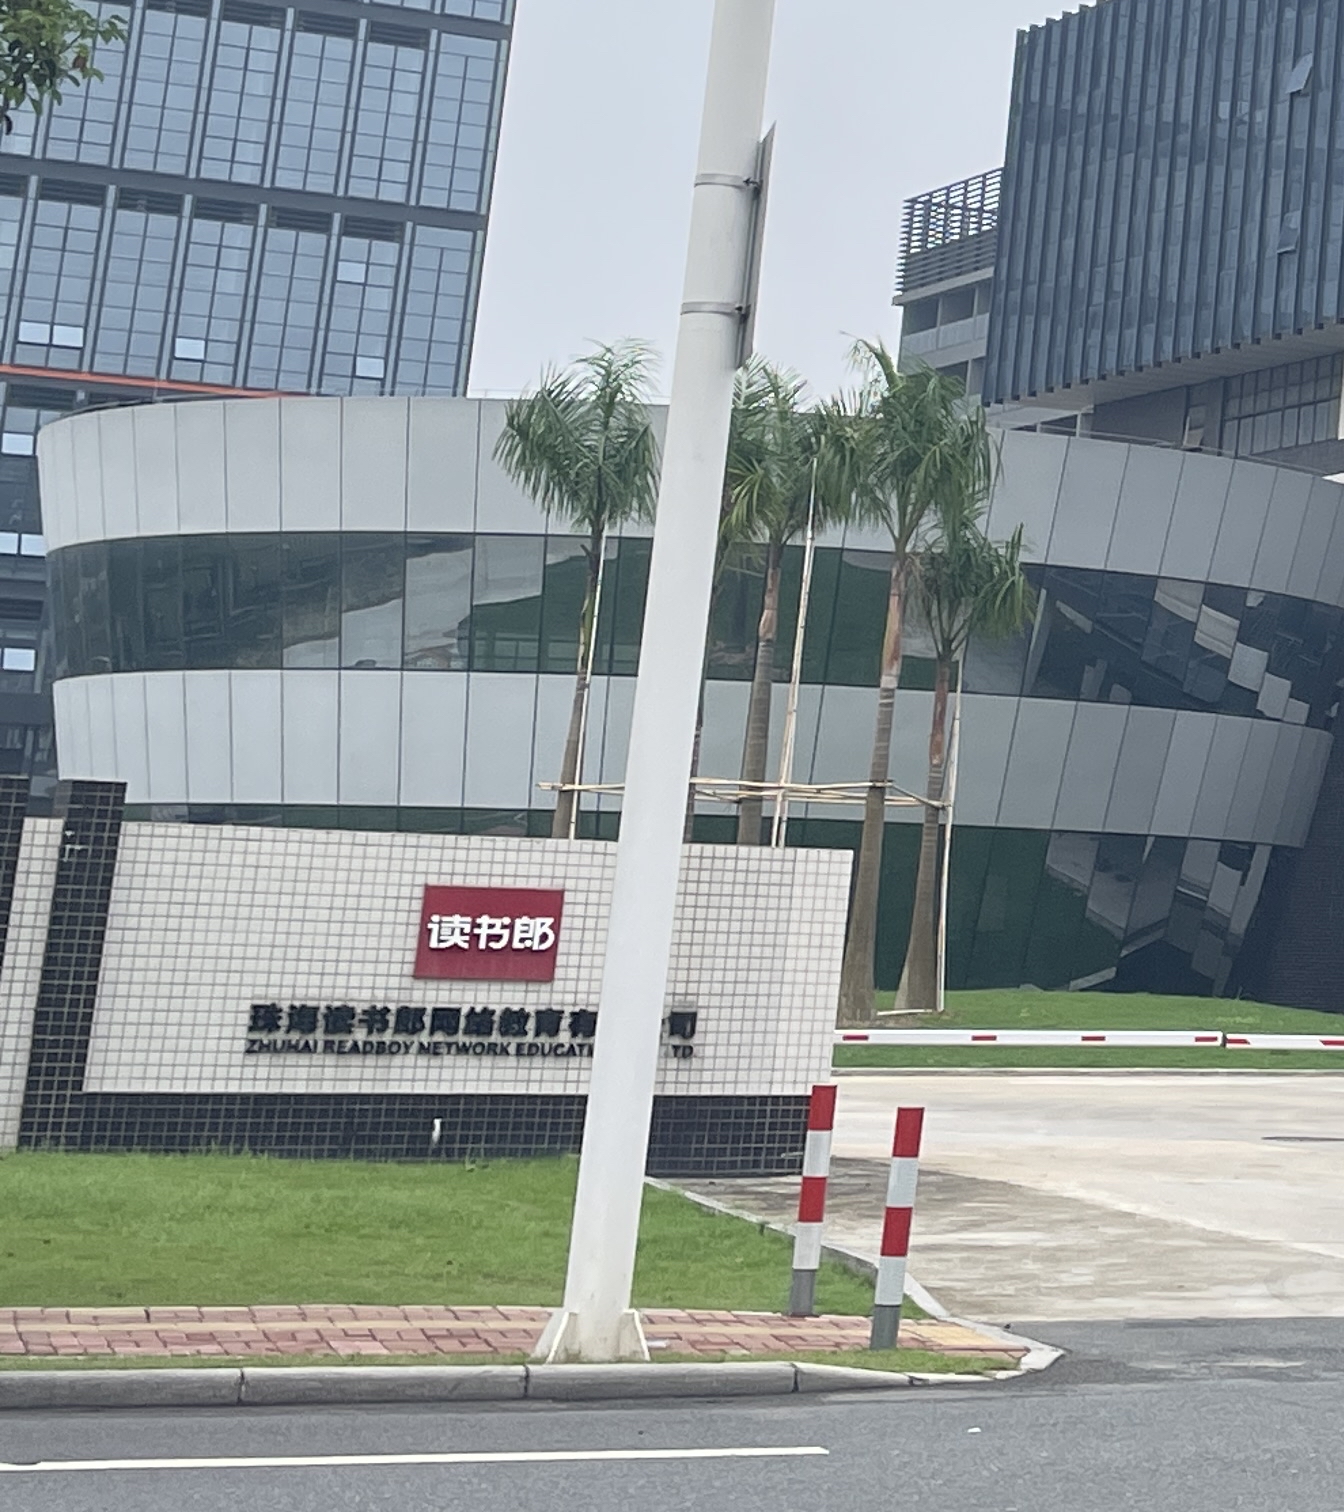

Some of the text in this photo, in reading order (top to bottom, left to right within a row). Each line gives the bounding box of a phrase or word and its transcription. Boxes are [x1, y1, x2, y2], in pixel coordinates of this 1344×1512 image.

[427, 914, 555, 950] 读书郎
[248, 1003, 698, 1039] 珠海读书郎网络教育有司
[244, 1039, 318, 1054] ZHUHAI
[322, 1040, 415, 1055] READBOY
[416, 1041, 511, 1056] NETWORK
